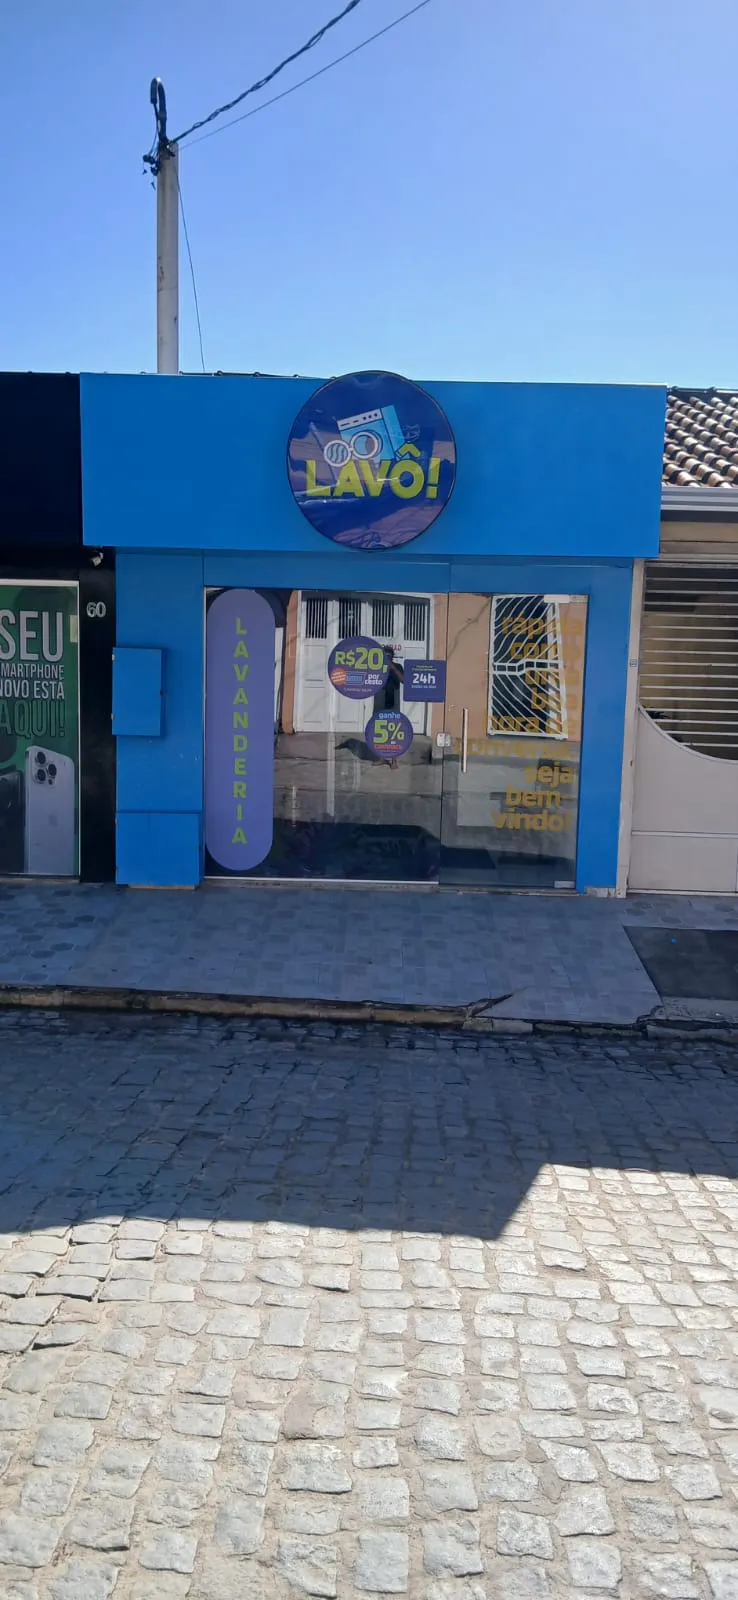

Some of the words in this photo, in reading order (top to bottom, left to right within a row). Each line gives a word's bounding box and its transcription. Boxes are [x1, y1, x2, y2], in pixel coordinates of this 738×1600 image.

[305, 443, 441, 500] LAVÔ!
[86, 601, 107, 618] 60
[0, 609, 64, 662] SEU
[0, 663, 65, 680] MARTPHONE
[412, 672, 436, 685] 24h
[0, 698, 65, 741] AQUI!
[231, 617, 250, 845] LAVANDERIA
[373, 719, 405, 744] 5%
[523, 759, 576, 788] seja
[490, 805, 573, 833] vindo!
